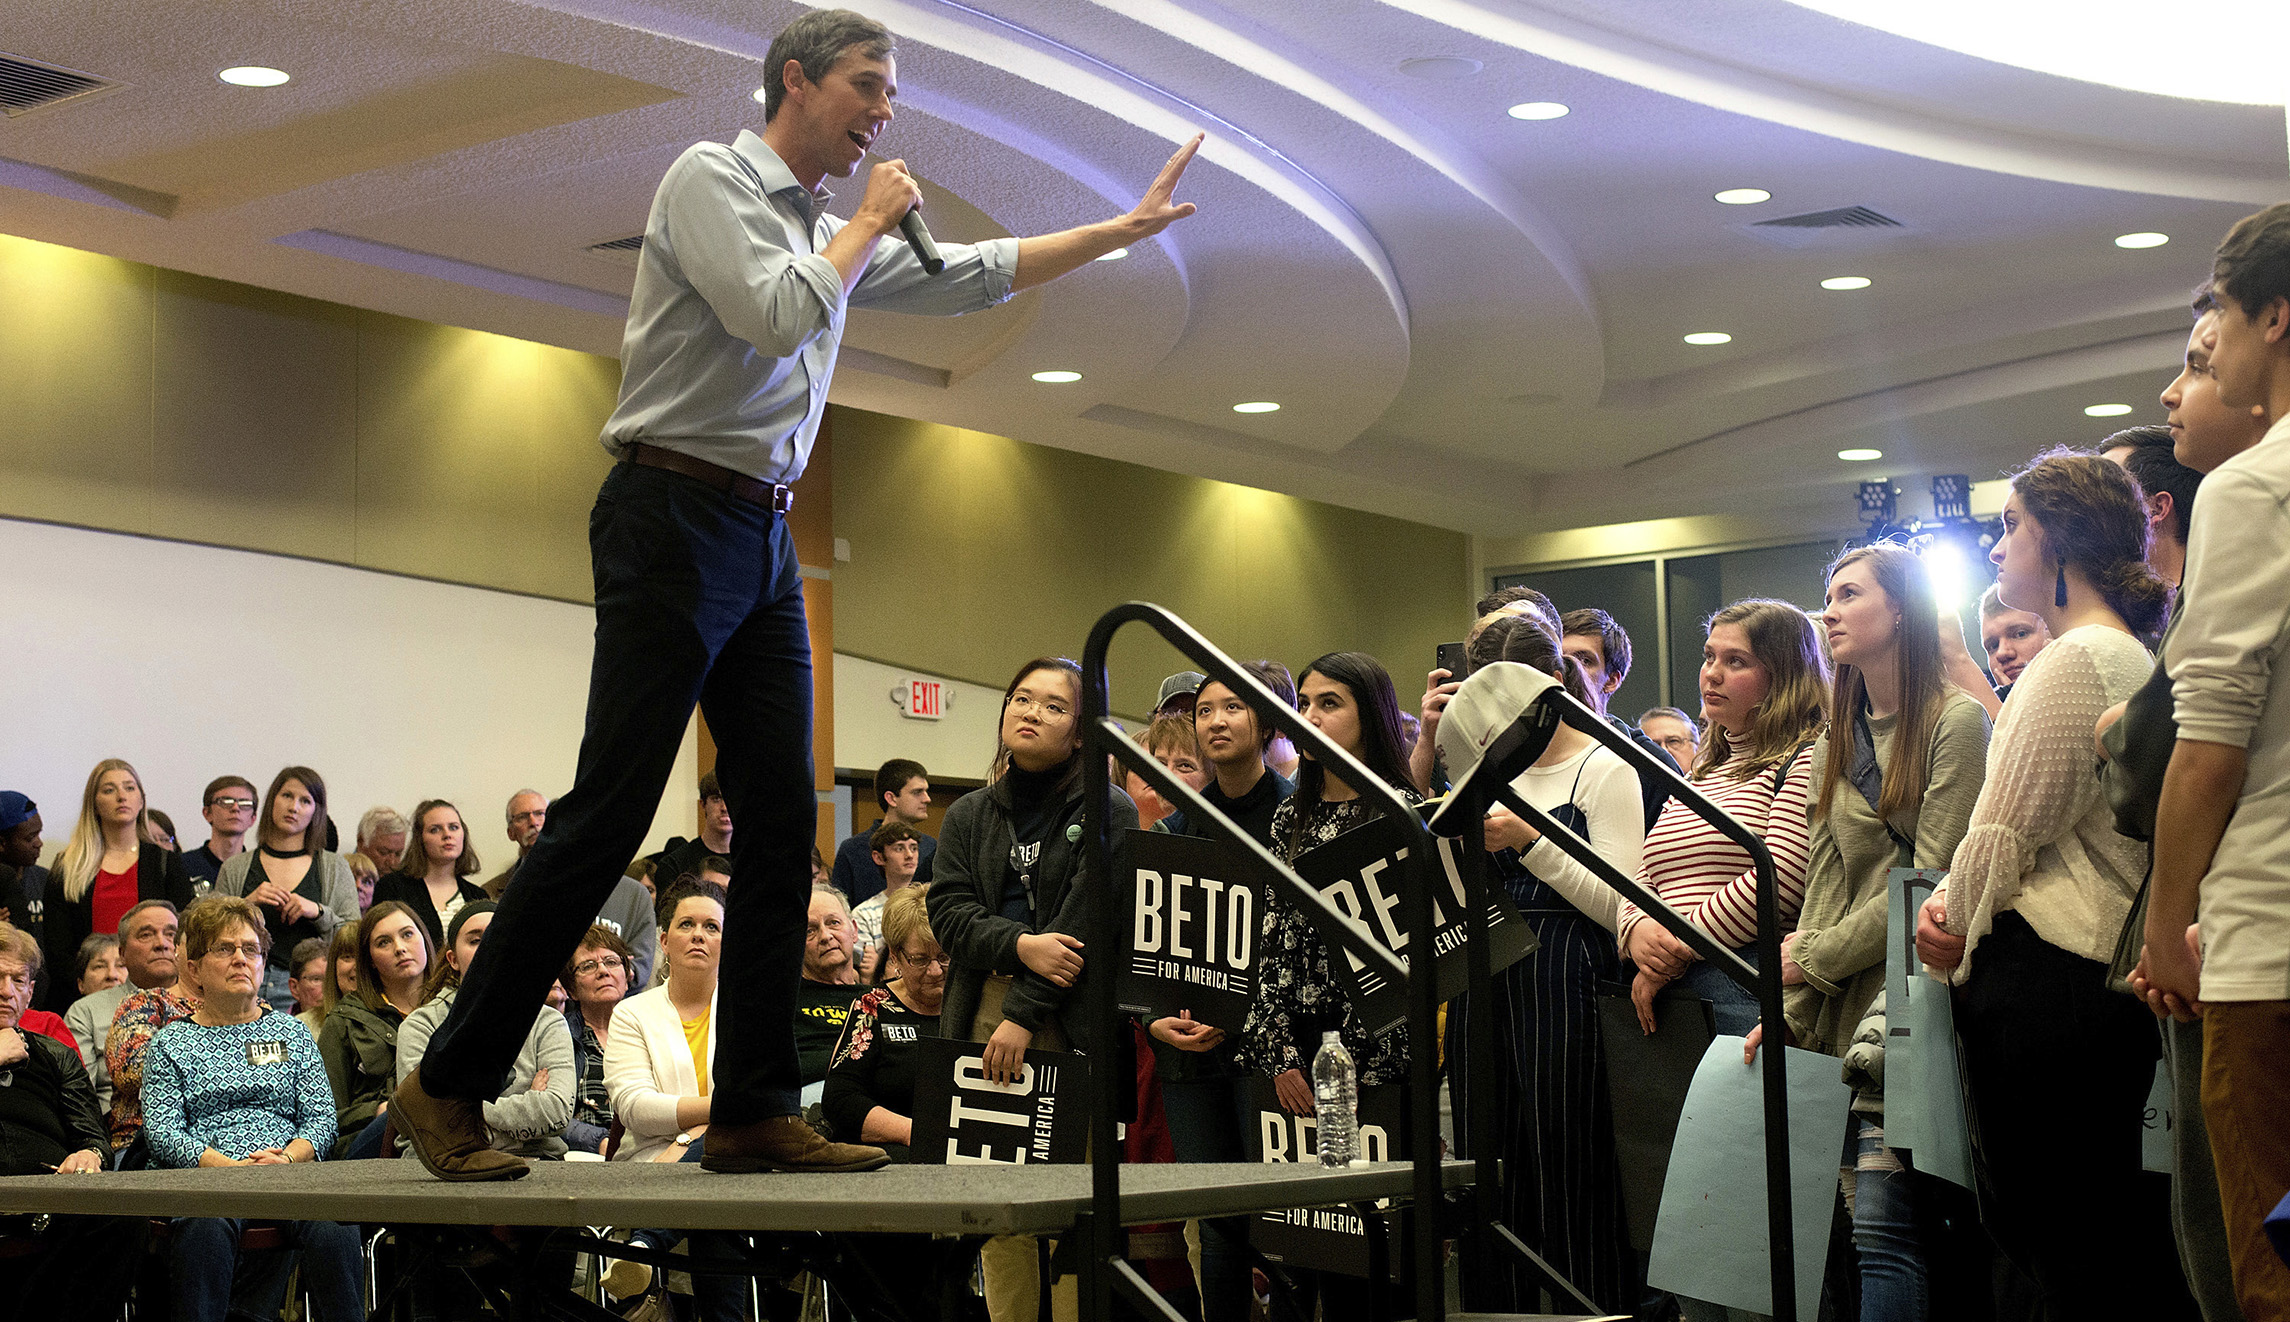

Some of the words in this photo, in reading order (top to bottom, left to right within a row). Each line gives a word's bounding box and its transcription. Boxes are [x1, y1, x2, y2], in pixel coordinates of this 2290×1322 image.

[912, 681, 941, 716] EXIT
[1134, 868, 1253, 971] BETO
[1158, 960, 1180, 981] FOR
[1184, 964, 1229, 991] AMERICA
[887, 1026, 917, 1039] BETO
[250, 1043, 282, 1059] BETO
[1032, 1096, 1055, 1161] AMERICA
[1286, 1208, 1308, 1227] FOR
[1313, 1210, 1364, 1236] AMERICA
